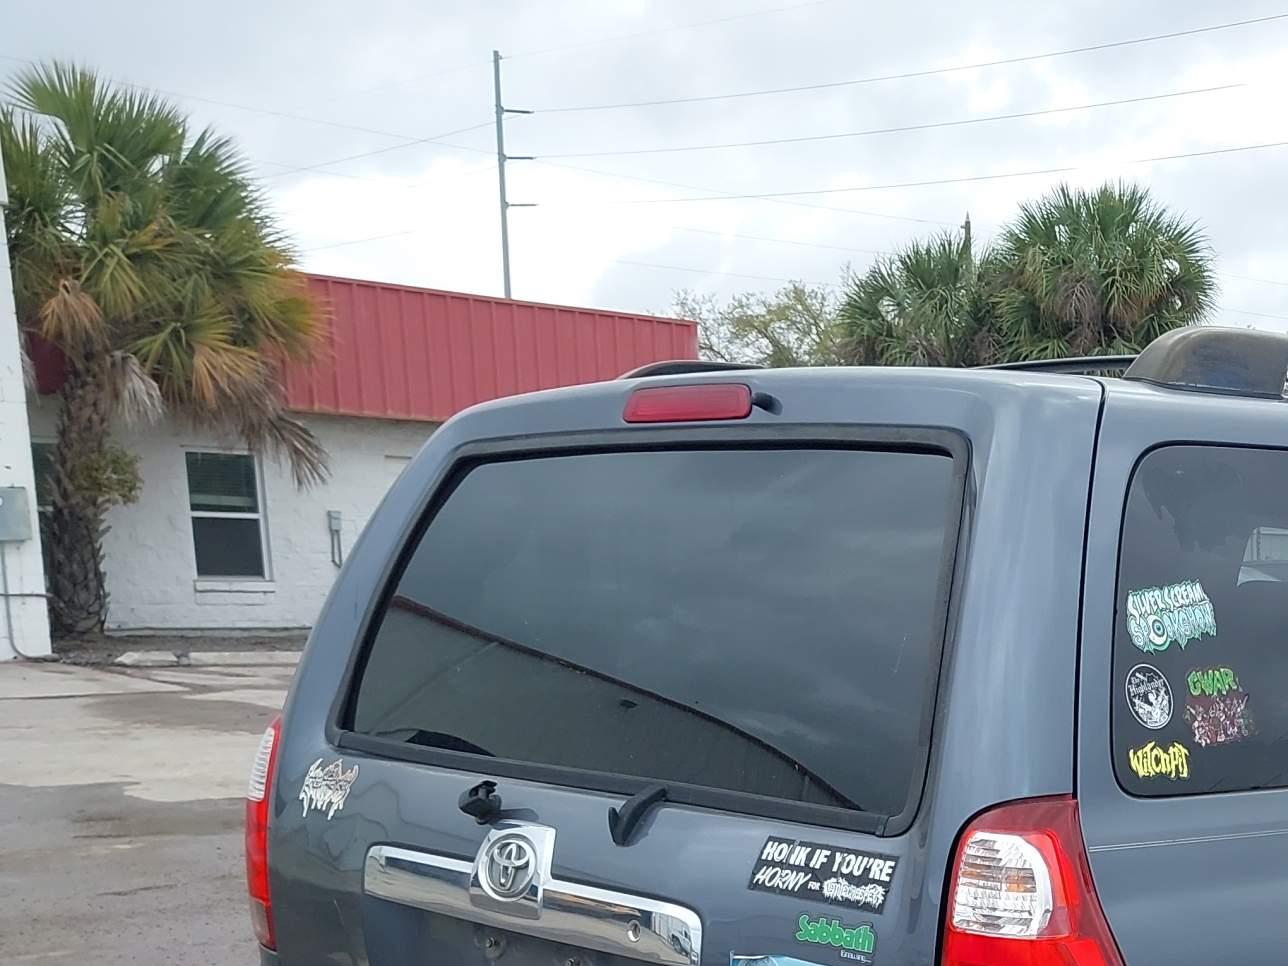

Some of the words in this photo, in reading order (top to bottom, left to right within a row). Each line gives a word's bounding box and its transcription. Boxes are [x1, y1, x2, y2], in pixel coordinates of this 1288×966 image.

[1127, 588, 1167, 622] SILVER
[1162, 581, 1209, 611] SCREAM
[1187, 667, 1237, 696] GWAR
[753, 865, 812, 892] HORNY
[807, 881, 821, 891] FOR
[809, 849, 831, 869] IF
[832, 852, 896, 882] YOU'RE
[796, 914, 874, 953] Sabbath
